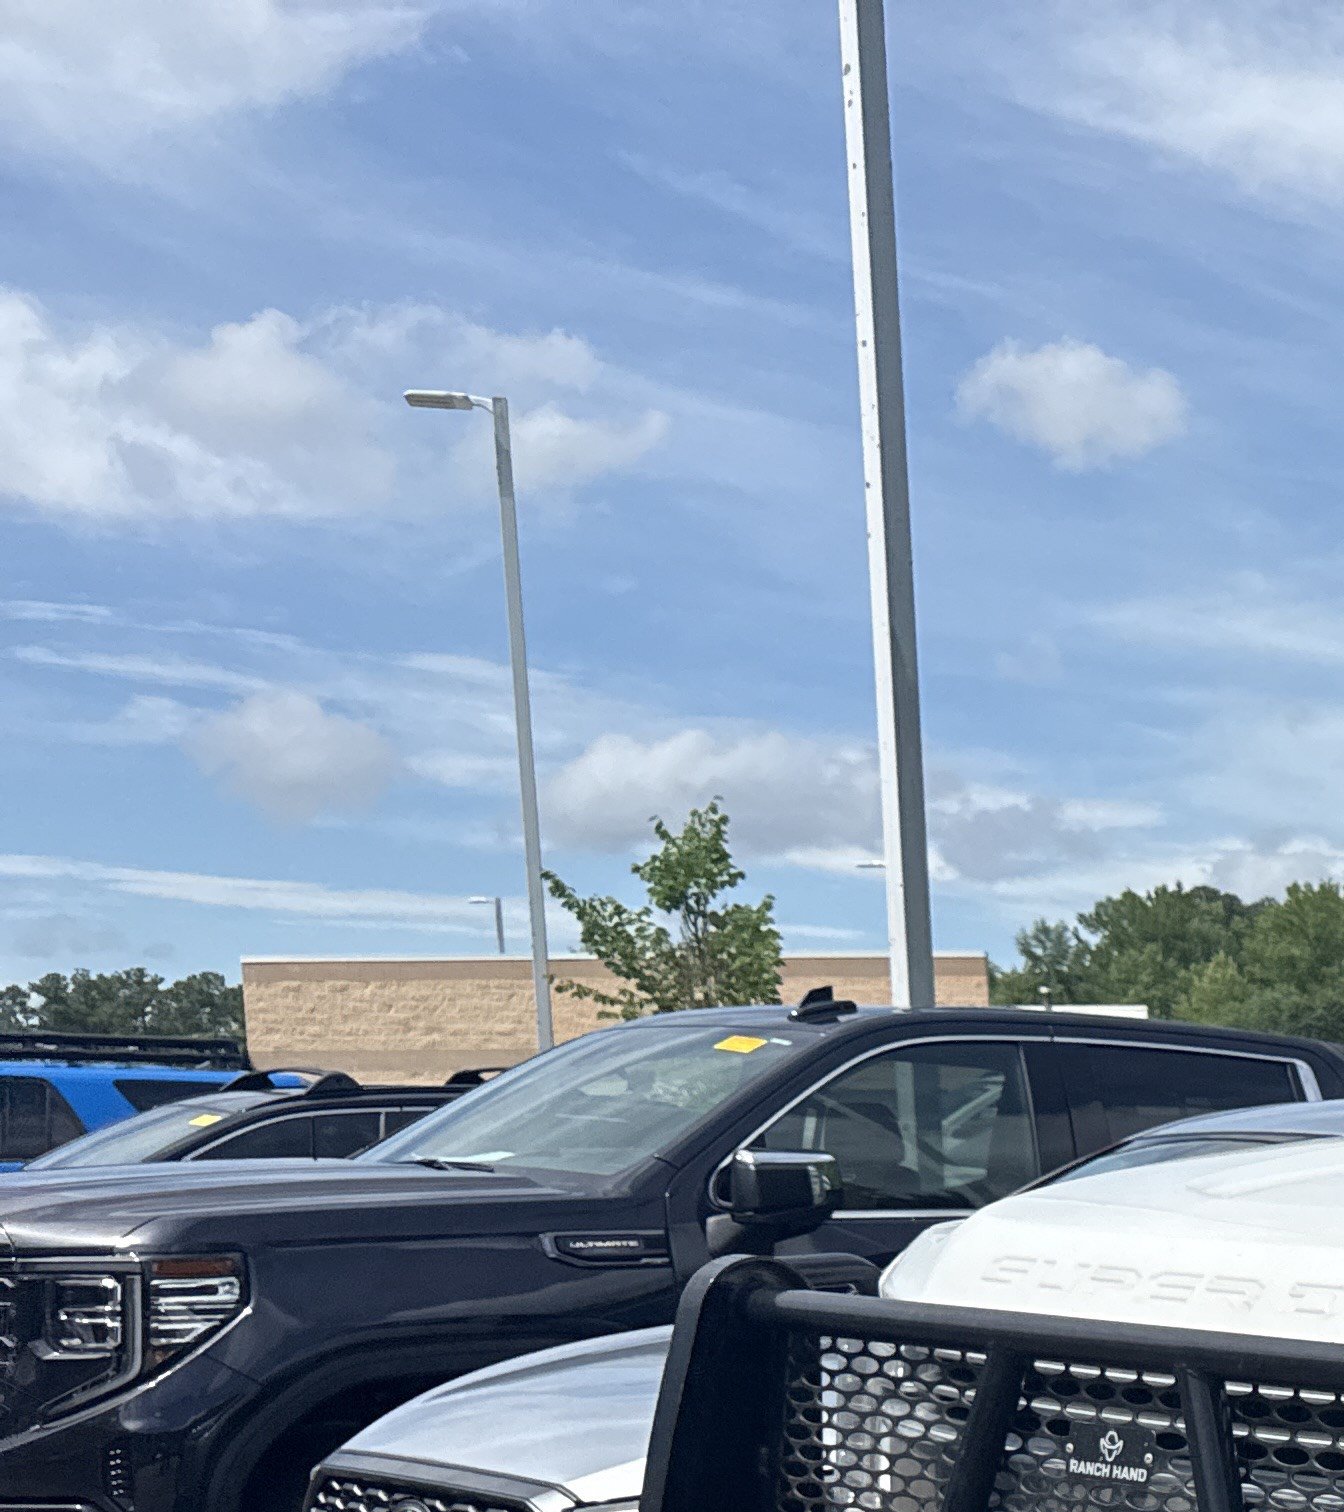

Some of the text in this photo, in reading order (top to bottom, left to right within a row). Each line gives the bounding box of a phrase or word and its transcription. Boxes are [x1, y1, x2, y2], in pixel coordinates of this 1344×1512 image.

[980, 1254, 1266, 1312] SUPER
[1069, 1458, 1148, 1483] RANCH HAND
